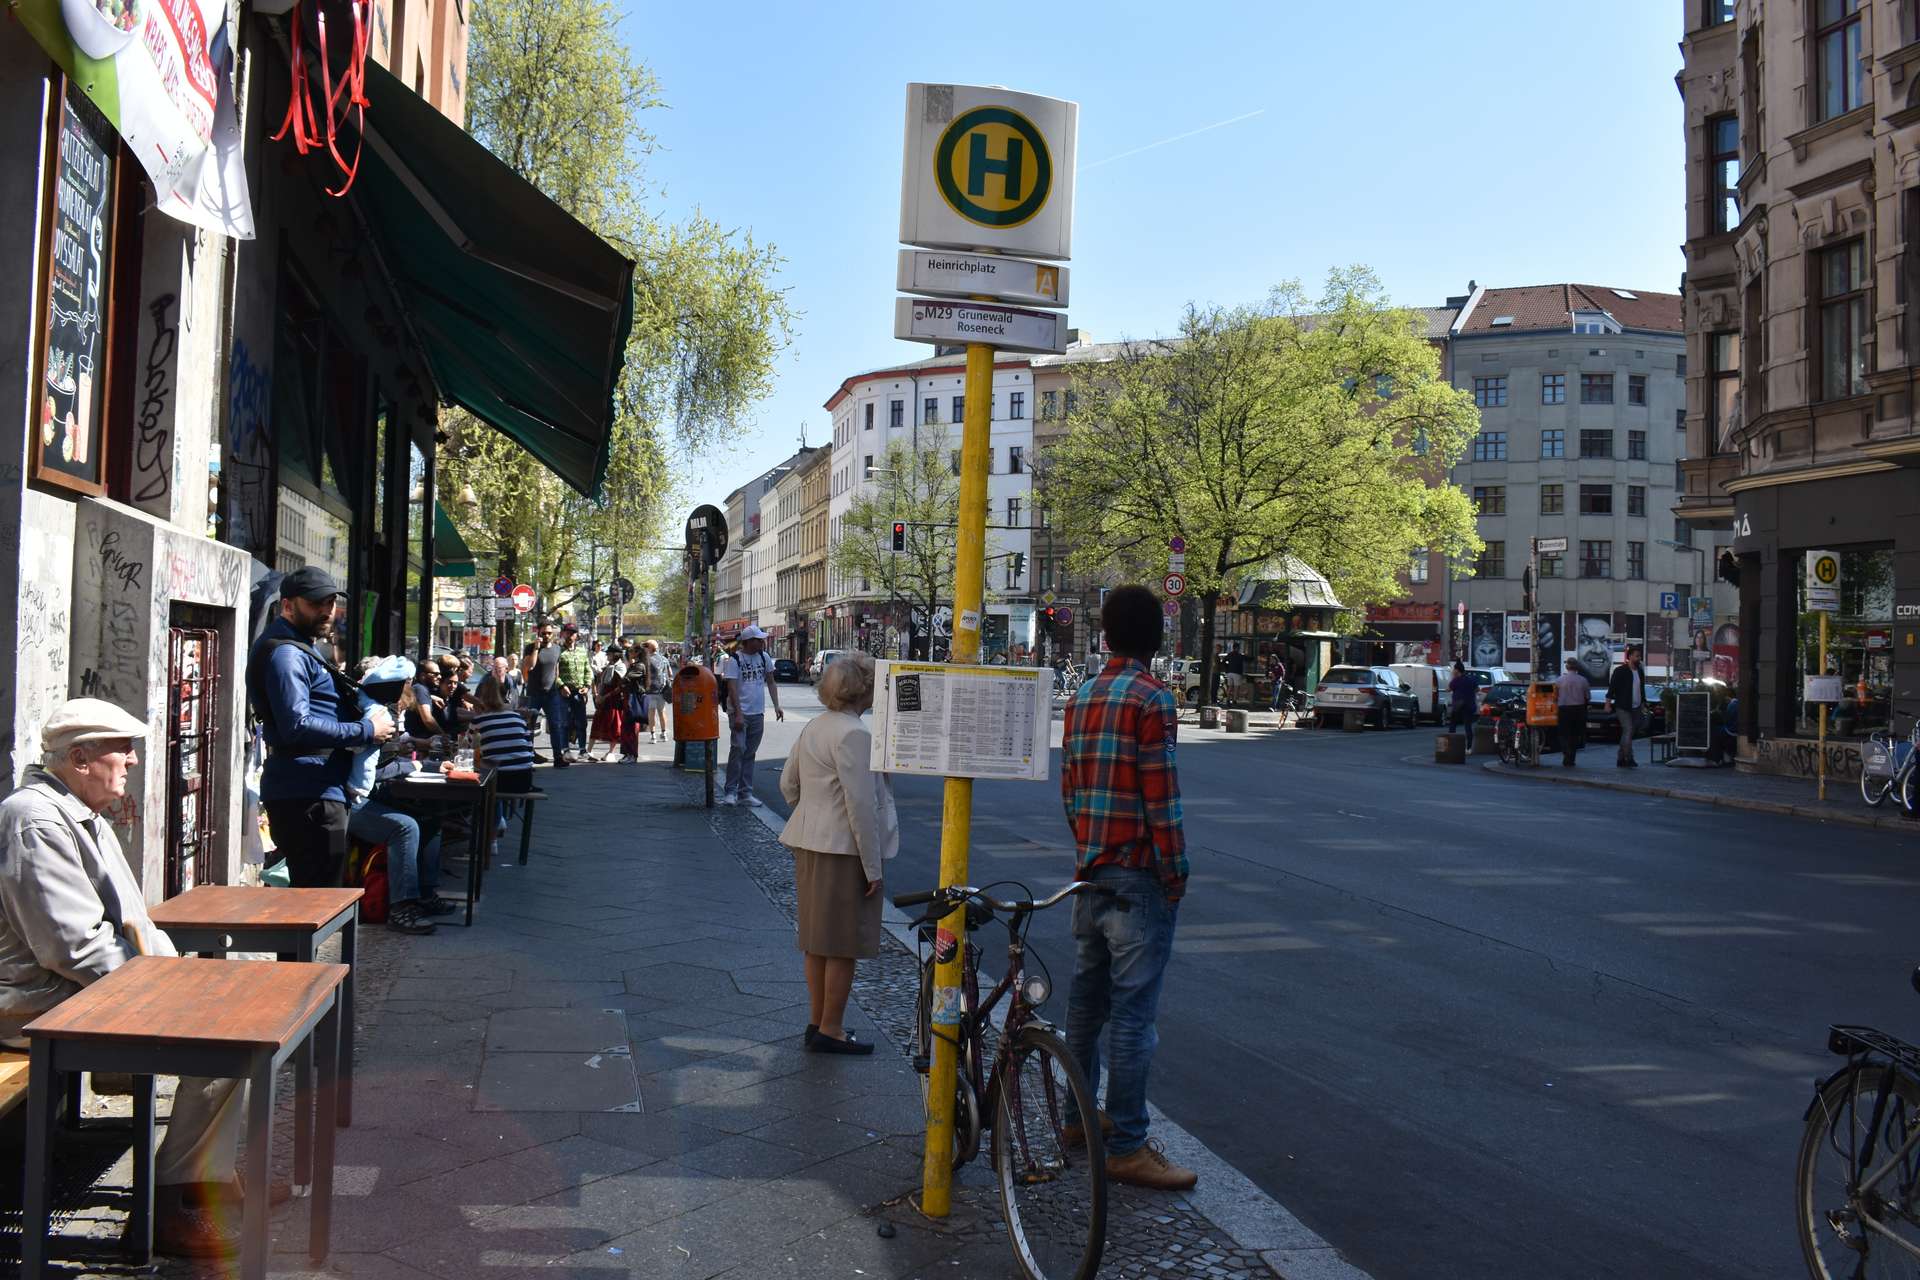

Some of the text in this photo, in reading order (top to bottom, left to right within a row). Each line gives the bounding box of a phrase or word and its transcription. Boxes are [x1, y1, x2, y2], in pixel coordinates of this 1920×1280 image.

[968, 133, 1023, 200] H
[928, 259, 996, 274] Heinrichplatz
[925, 307, 953, 320] M29
[958, 309, 1013, 323] Grunewald
[957, 321, 1005, 335] Roseneck
[1822, 562, 1834, 578] H
[1168, 580, 1180, 590] 30
